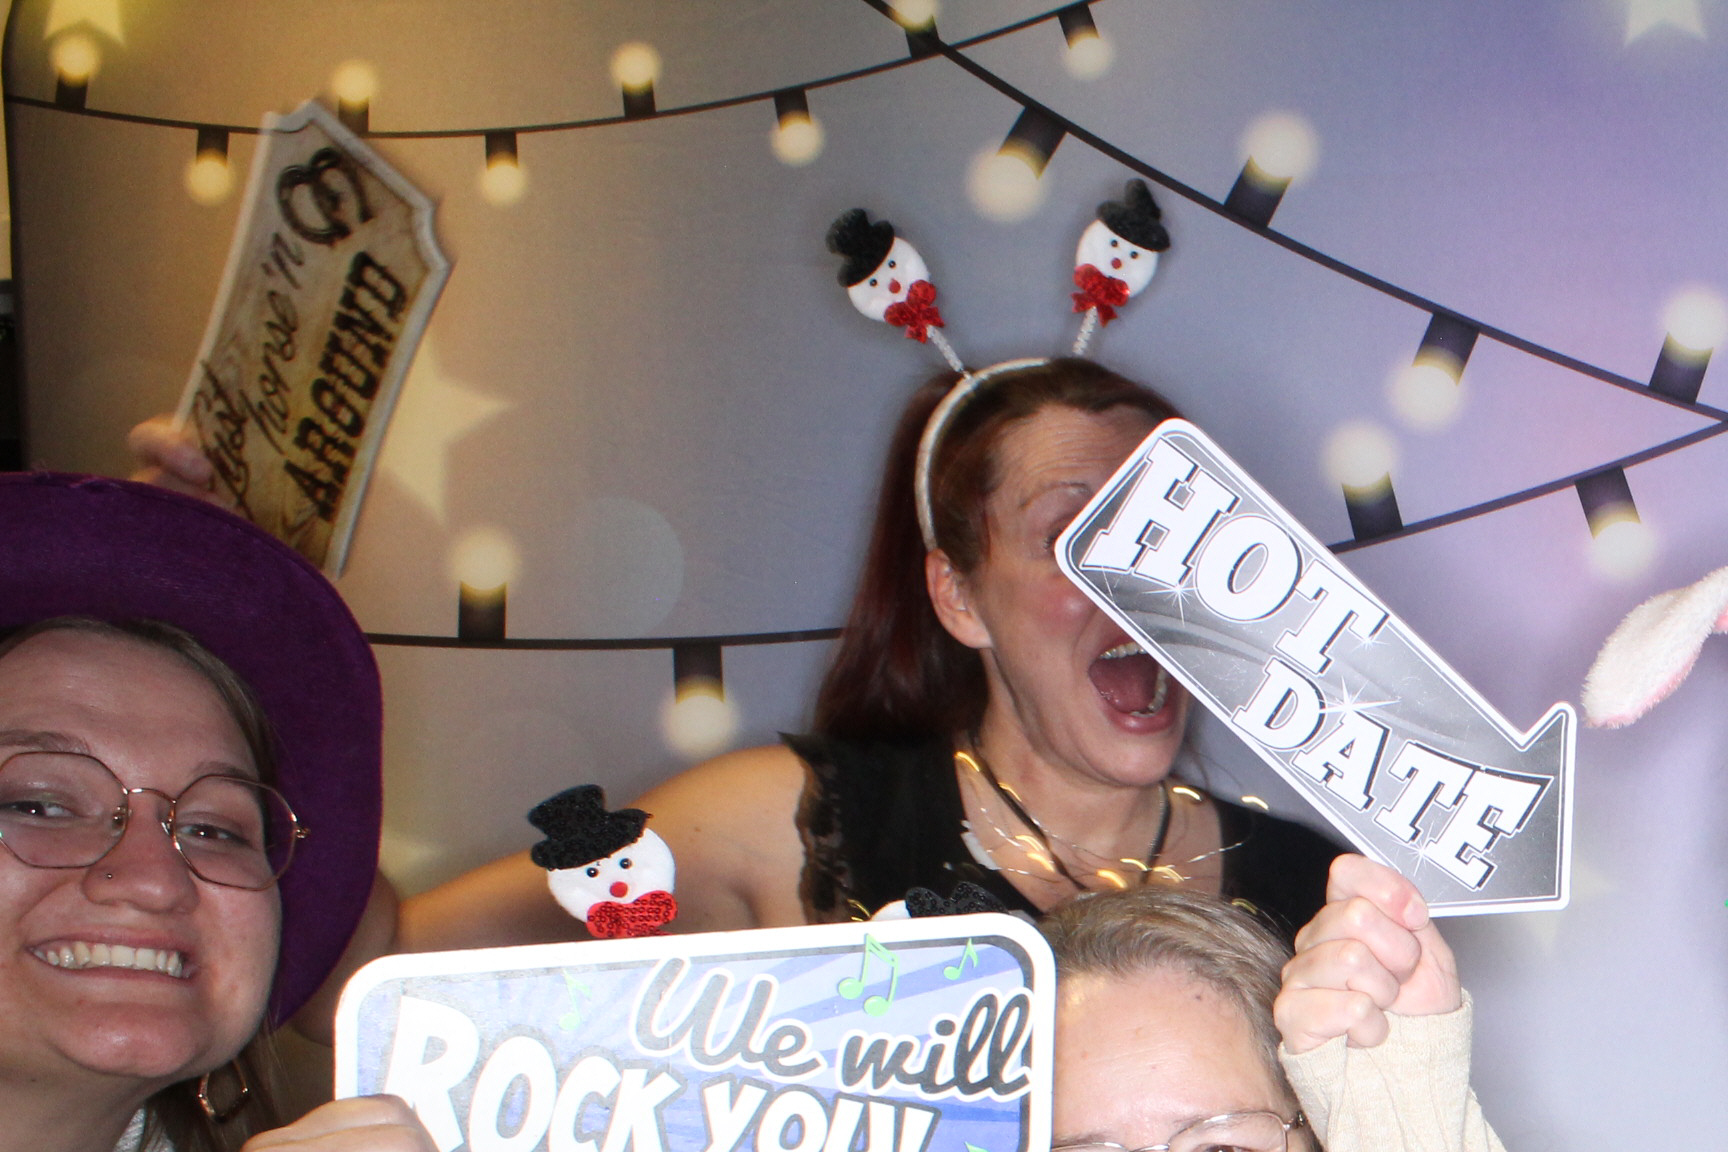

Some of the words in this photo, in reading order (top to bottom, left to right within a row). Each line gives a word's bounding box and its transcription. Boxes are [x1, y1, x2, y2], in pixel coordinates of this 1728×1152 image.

[283, 250, 408, 523] AROUND
[1080, 436, 1390, 678] HOT
[1230, 657, 1554, 891] DATE
[632, 955, 820, 1078] We
[839, 992, 1032, 1097] will
